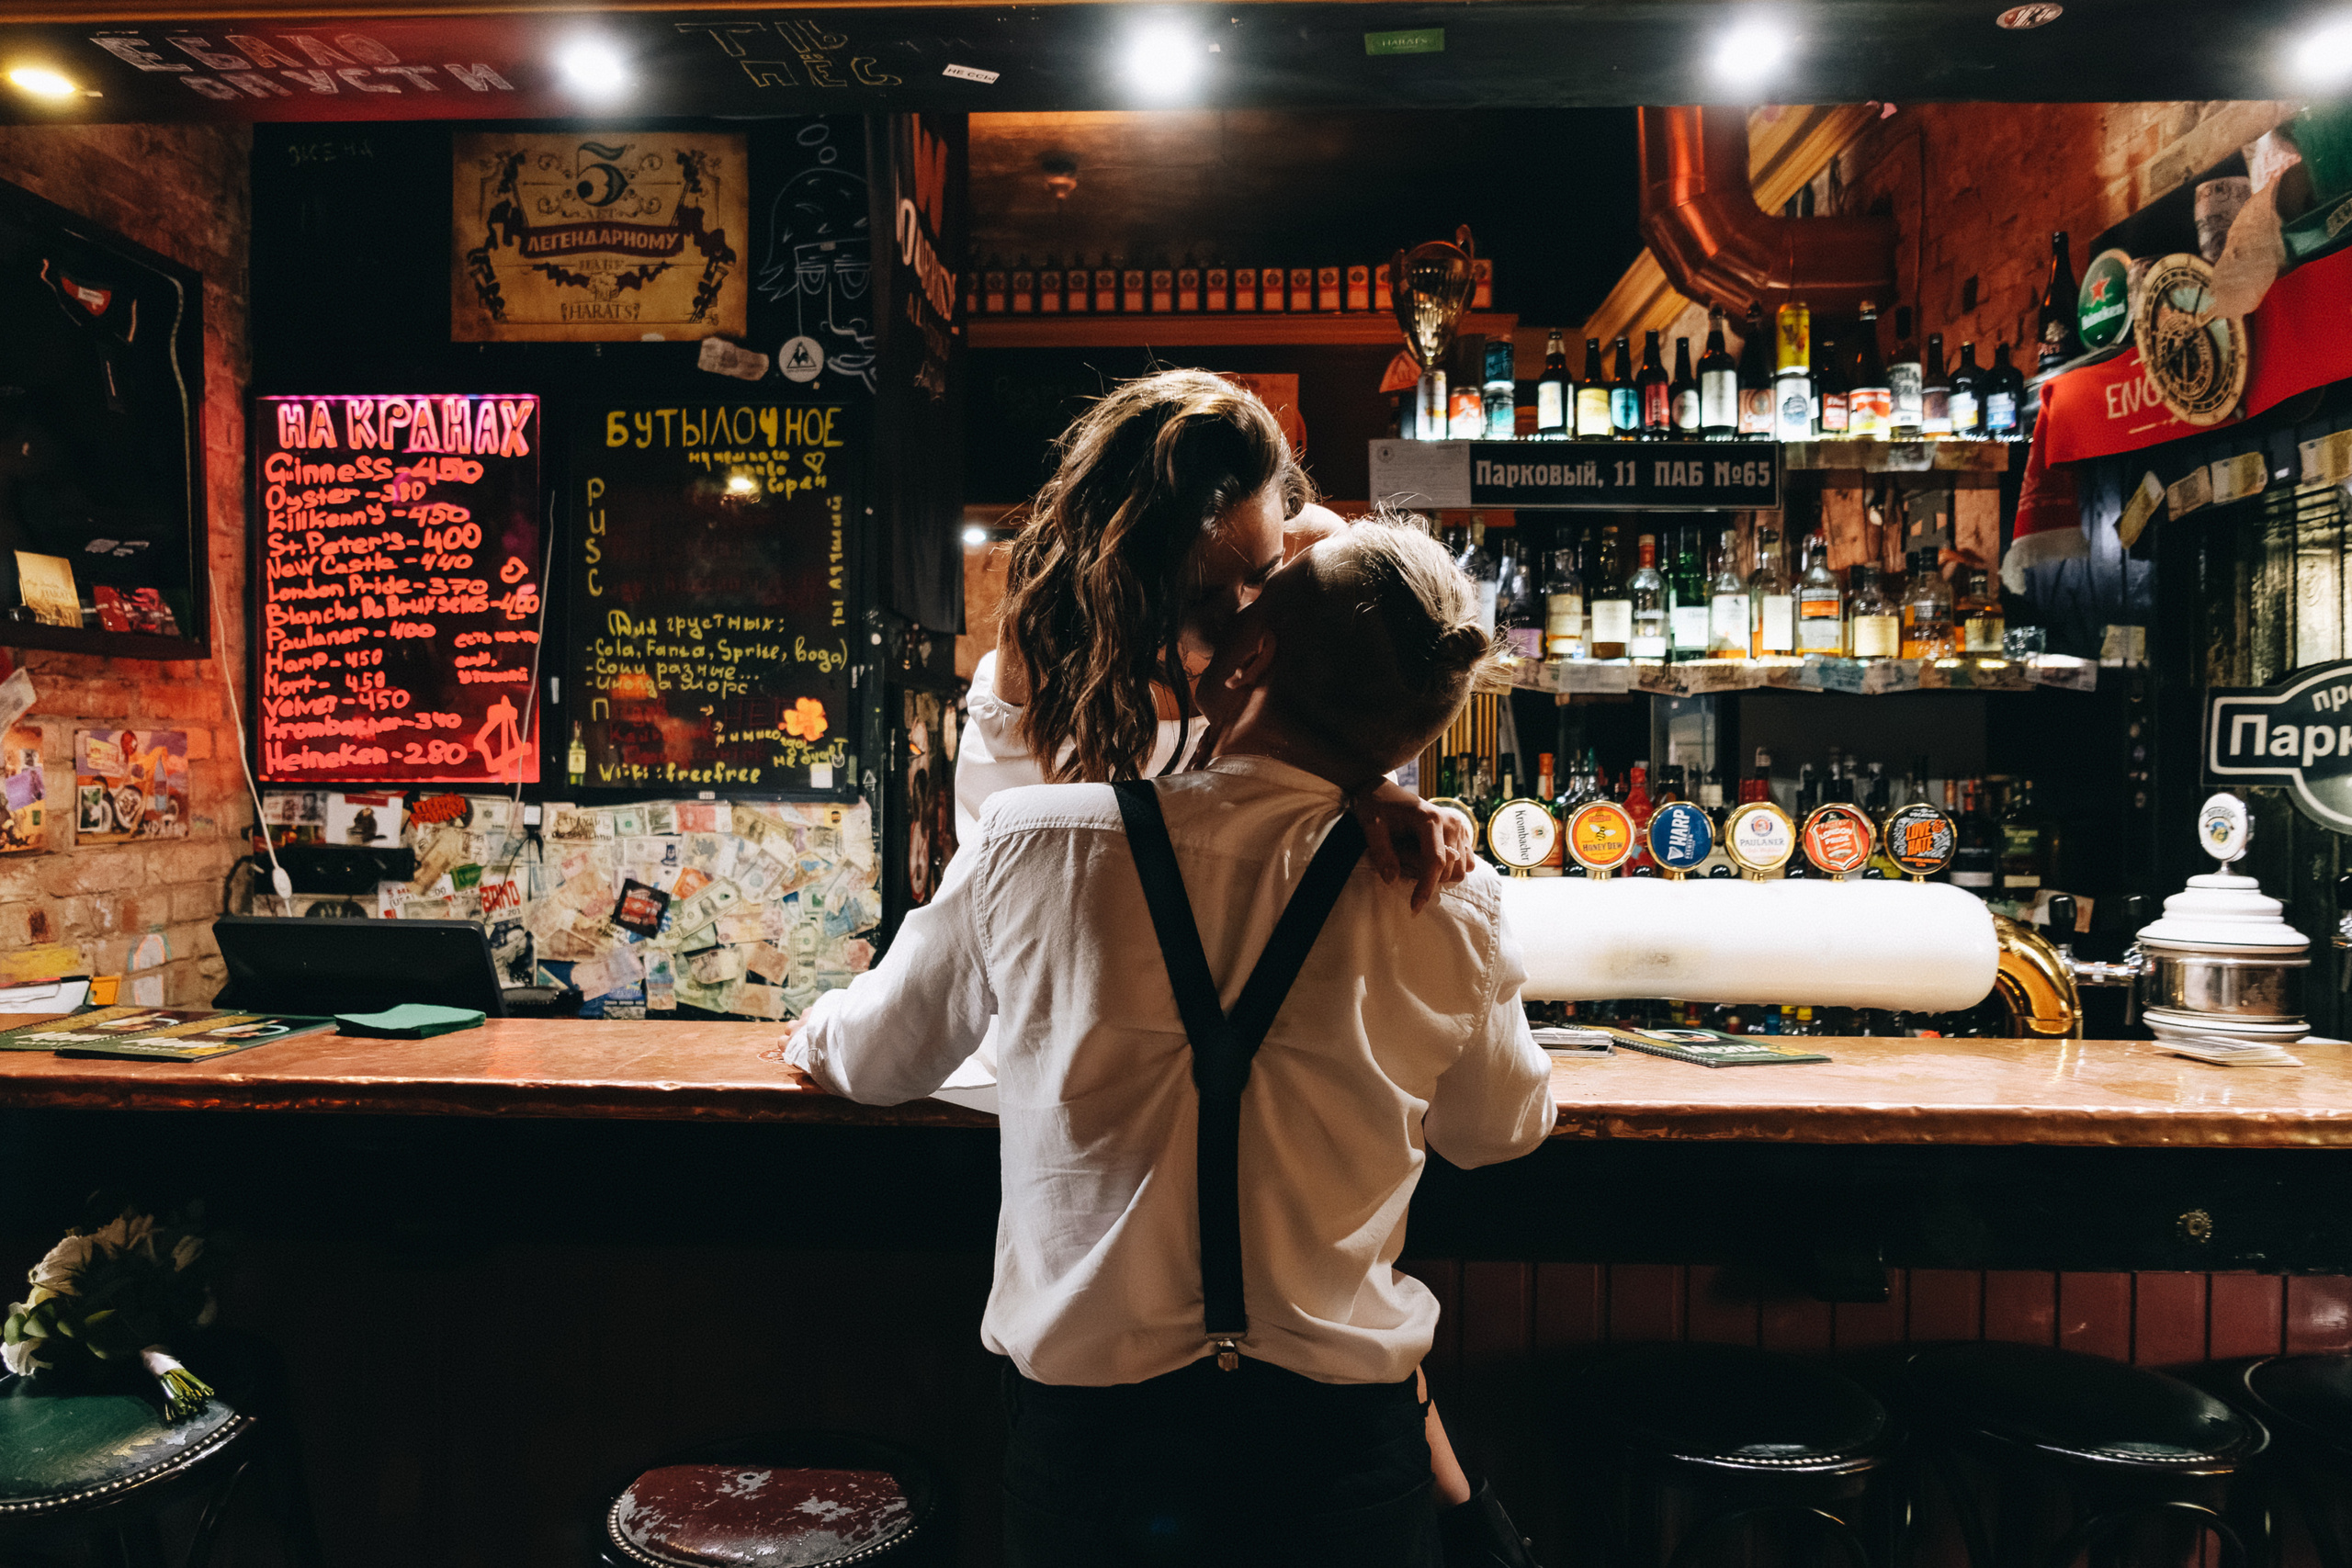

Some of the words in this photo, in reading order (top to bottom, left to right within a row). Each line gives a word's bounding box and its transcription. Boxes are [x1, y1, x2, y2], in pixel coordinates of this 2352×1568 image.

[575, 141, 635, 207] 5
[527, 229, 679, 253] ЛЕГЕНДАРНОМУ
[277, 400, 338, 449] НА
[345, 398, 534, 457] КРАНАХ
[606, 406, 844, 448] БУТЫЛОЧНОЕ
[1476, 460, 1604, 488] Парковый,
[1613, 460, 1637, 487] 11
[1654, 460, 1703, 487] ПАБ
[268, 578, 345, 602] London
[348, 574, 413, 596] Pride
[266, 600, 359, 627] Blanche
[266, 626, 368, 651] Paulaner
[2312, 685, 2352, 712] пр
[1514, 809, 1531, 862] Krombacher
[1668, 809, 1690, 846] HARP
[1819, 828, 1853, 840] LONDON
[1825, 835, 1849, 845] PRIDE
[1905, 820, 1932, 840] LOVE
[1582, 842, 1605, 852] HONEY
[1607, 841, 1623, 850] DEW
[1740, 838, 1784, 846] PAULANER
[1907, 836, 1933, 856] HATE
